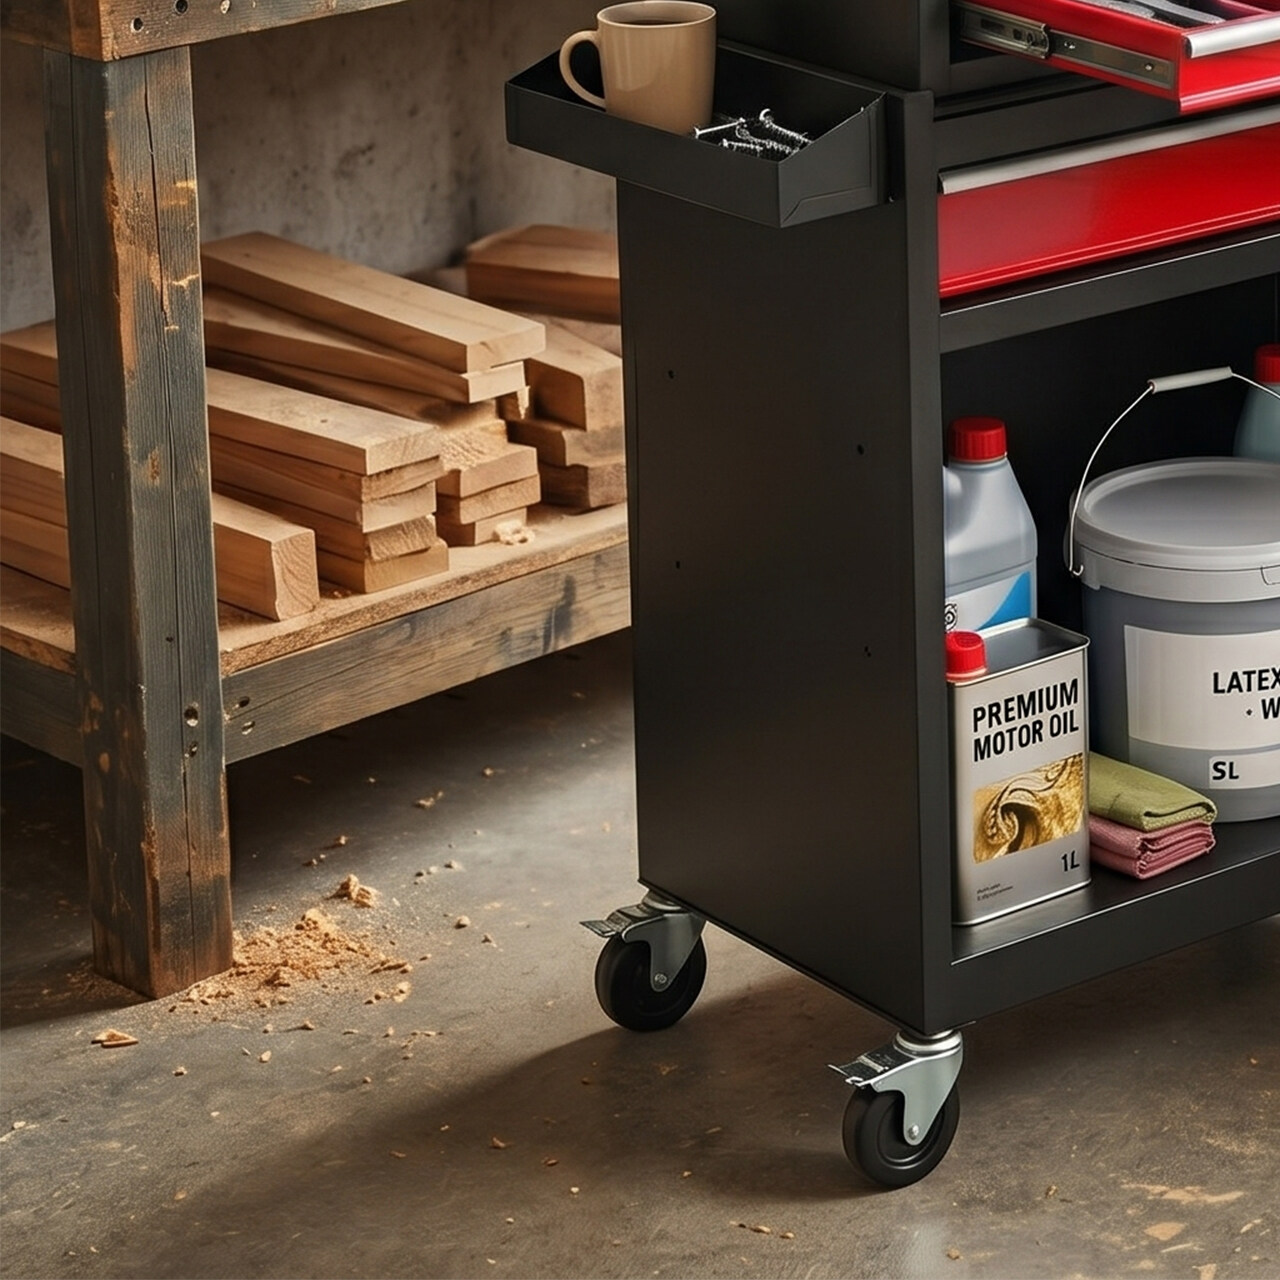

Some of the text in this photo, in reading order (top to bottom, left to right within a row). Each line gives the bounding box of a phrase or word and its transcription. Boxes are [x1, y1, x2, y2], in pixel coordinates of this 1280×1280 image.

[973, 678, 1078, 733] PREMIUM
[974, 709, 1079, 762] MOTOR OIL
[1061, 850, 1080, 872] 1L
